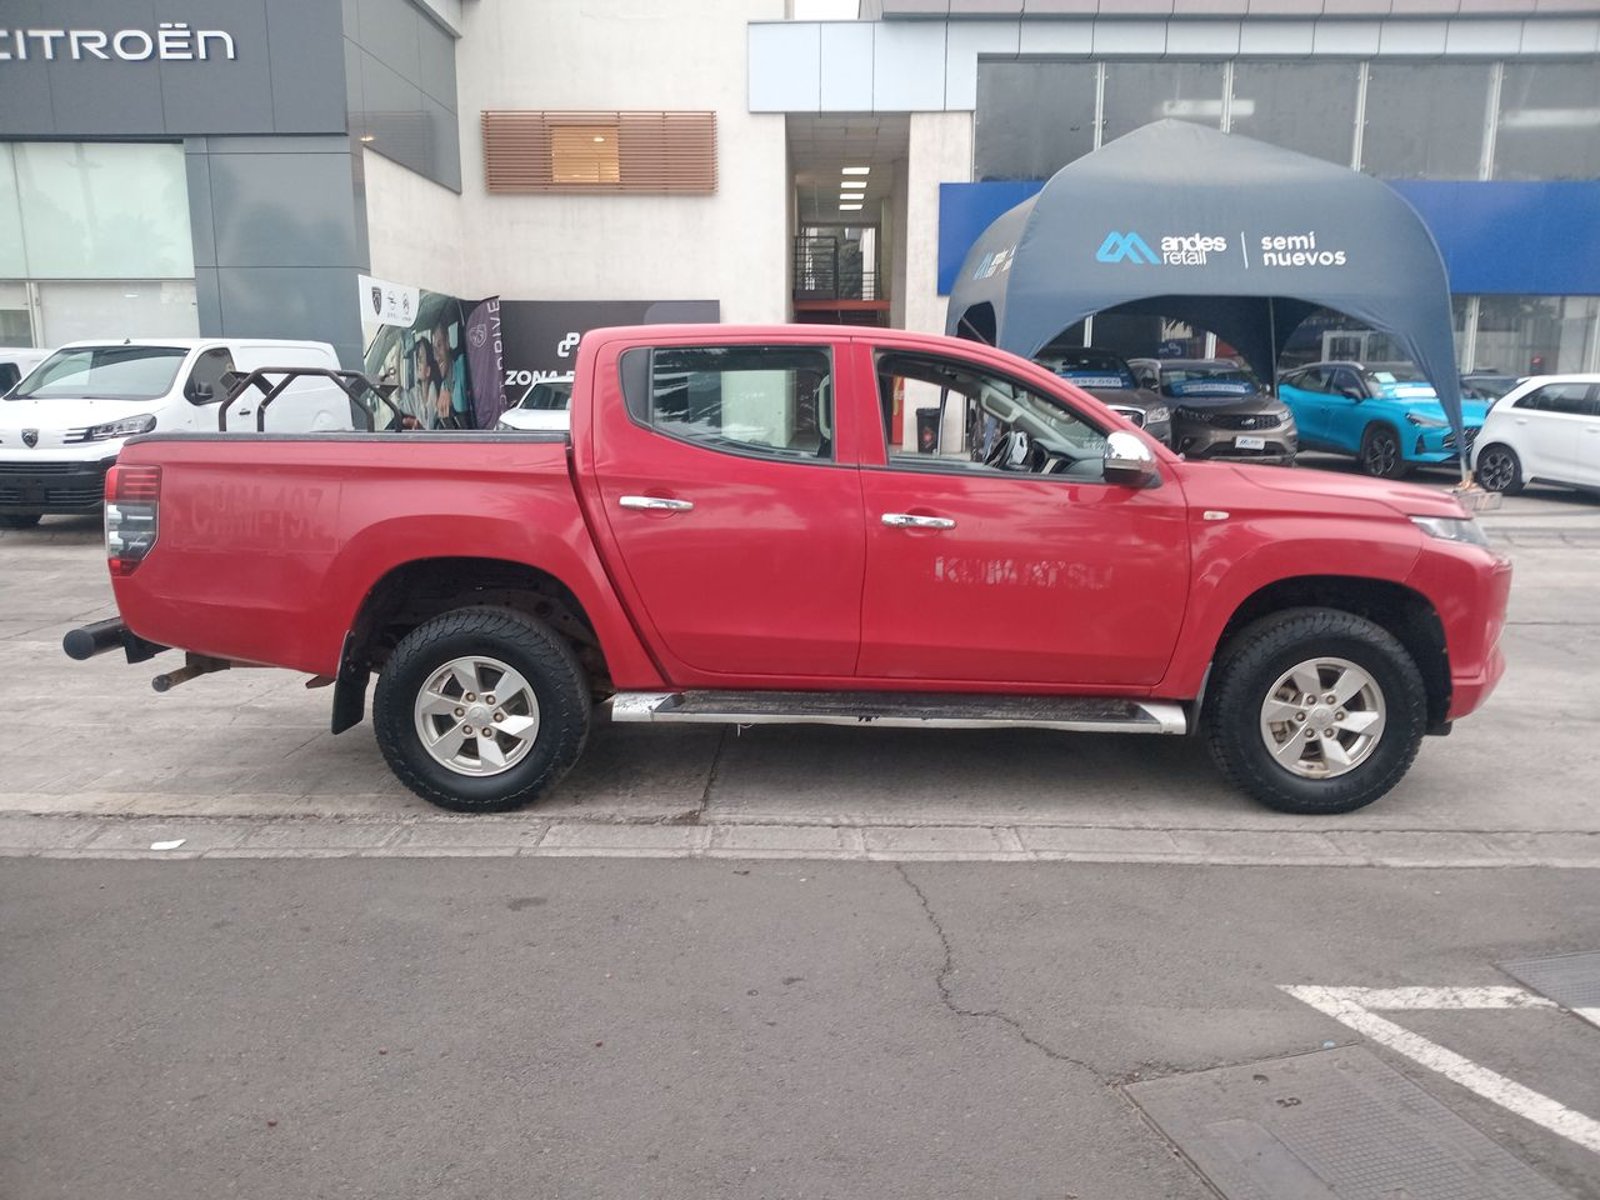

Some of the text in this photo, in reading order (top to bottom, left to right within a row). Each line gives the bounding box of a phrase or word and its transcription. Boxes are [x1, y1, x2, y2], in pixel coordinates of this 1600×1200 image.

[1161, 232, 1227, 251] andes
[1163, 249, 1207, 265] retail
[1263, 250, 1346, 266] nuevos
